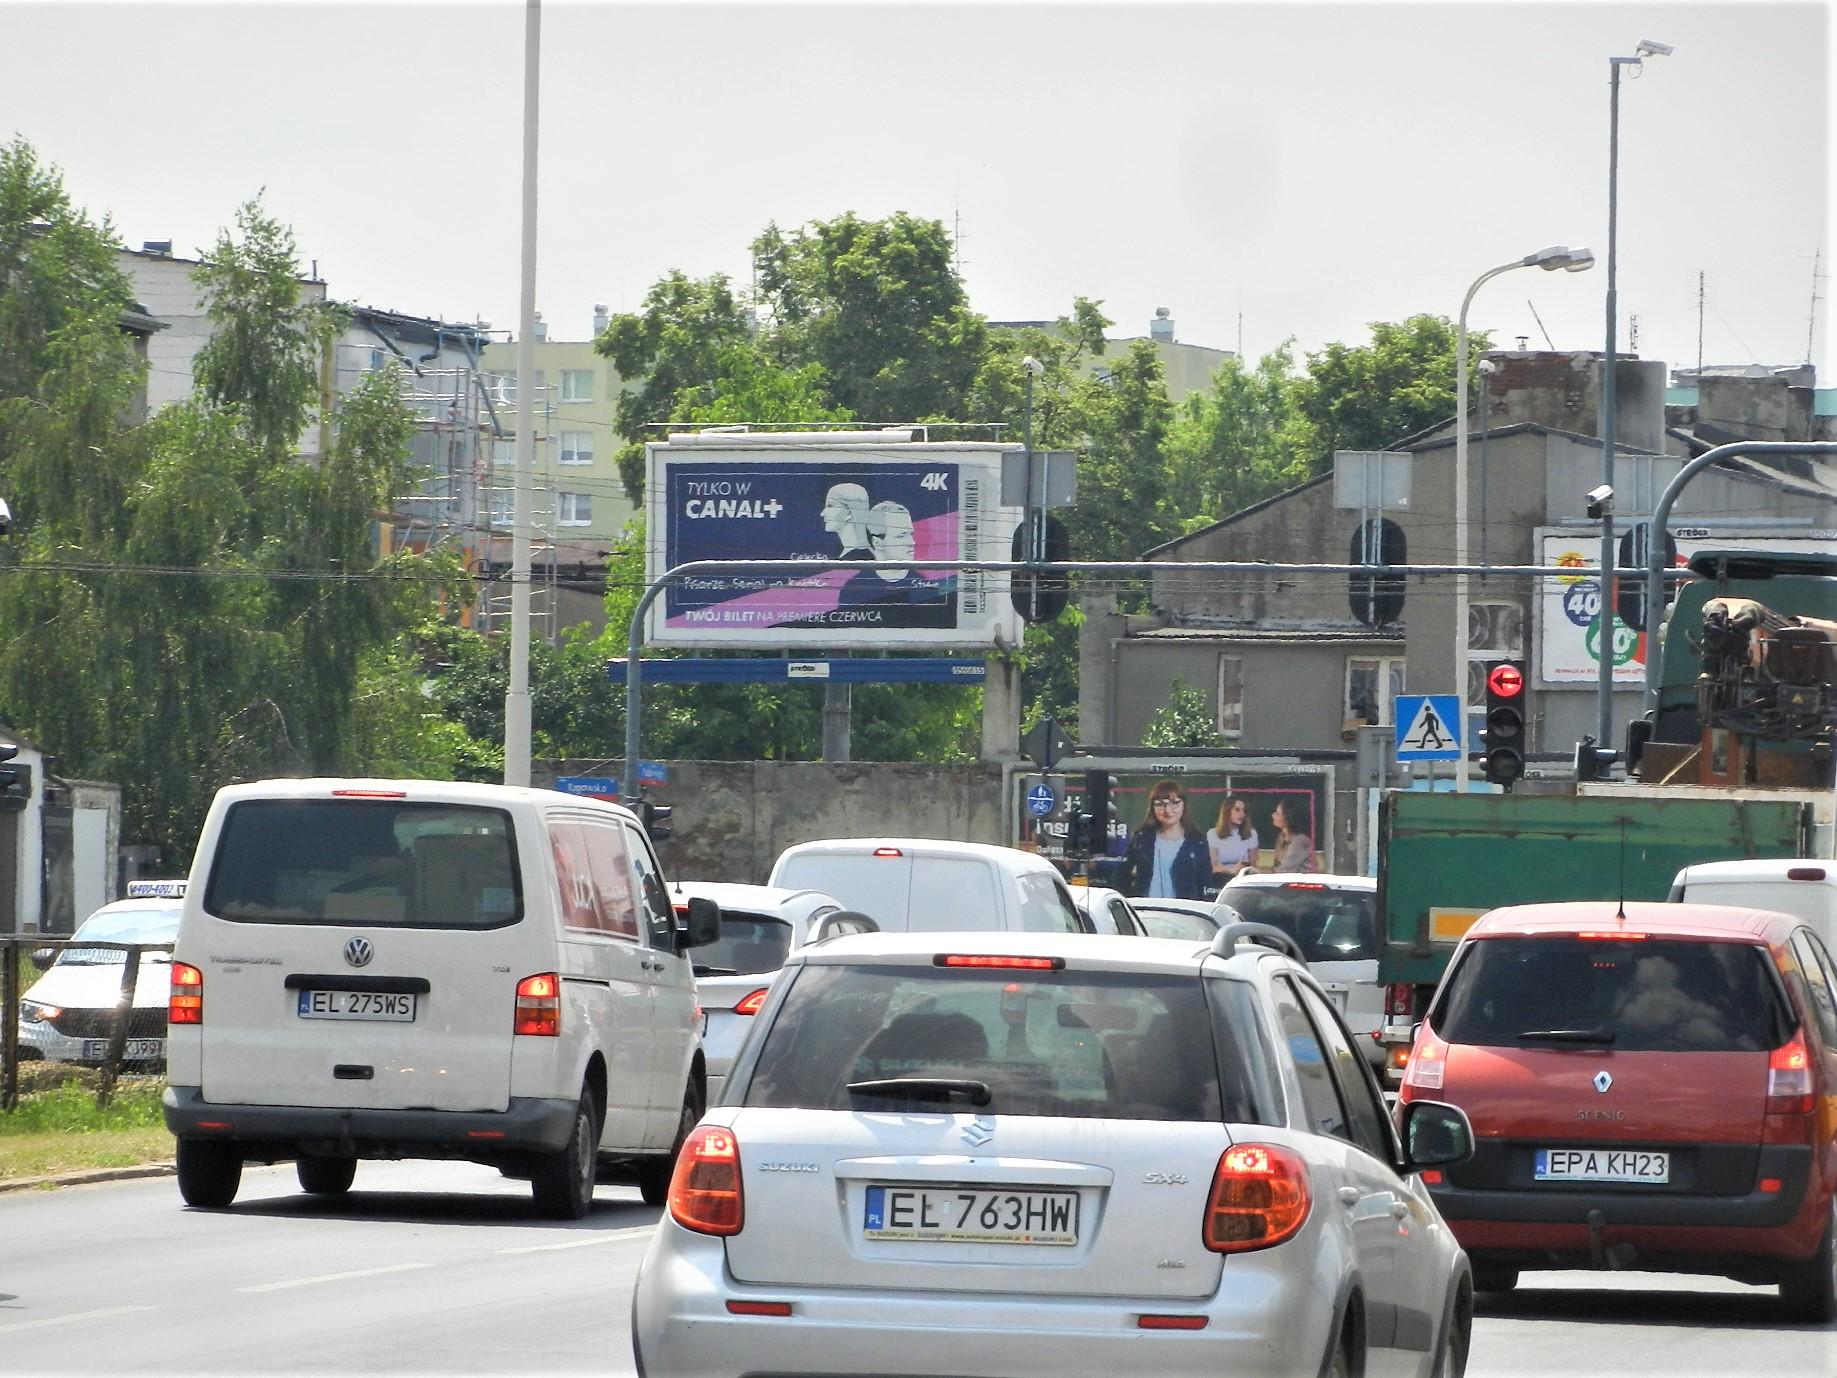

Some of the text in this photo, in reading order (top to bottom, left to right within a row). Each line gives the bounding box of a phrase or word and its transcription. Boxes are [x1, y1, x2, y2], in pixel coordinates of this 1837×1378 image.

[688, 482, 752, 496] TYLKO W
[920, 472, 949, 491] 4K
[686, 498, 783, 519] CANAL+
[685, 608, 720, 622] TWÓJ
[724, 611, 754, 622] BILET
[757, 611, 775, 621] NA
[829, 611, 883, 623] CZERWCA
[313, 992, 340, 1013] EL
[348, 993, 410, 1015] 275WS
[1577, 1109, 1625, 1121] SCENIC
[758, 1161, 820, 1173] SUZUKI
[1550, 1152, 1598, 1174] EPA
[1608, 1153, 1666, 1176] KH23
[1142, 1171, 1189, 1186] SX4
[868, 1214, 881, 1225] PL
[956, 1195, 1071, 1233] 763HW
